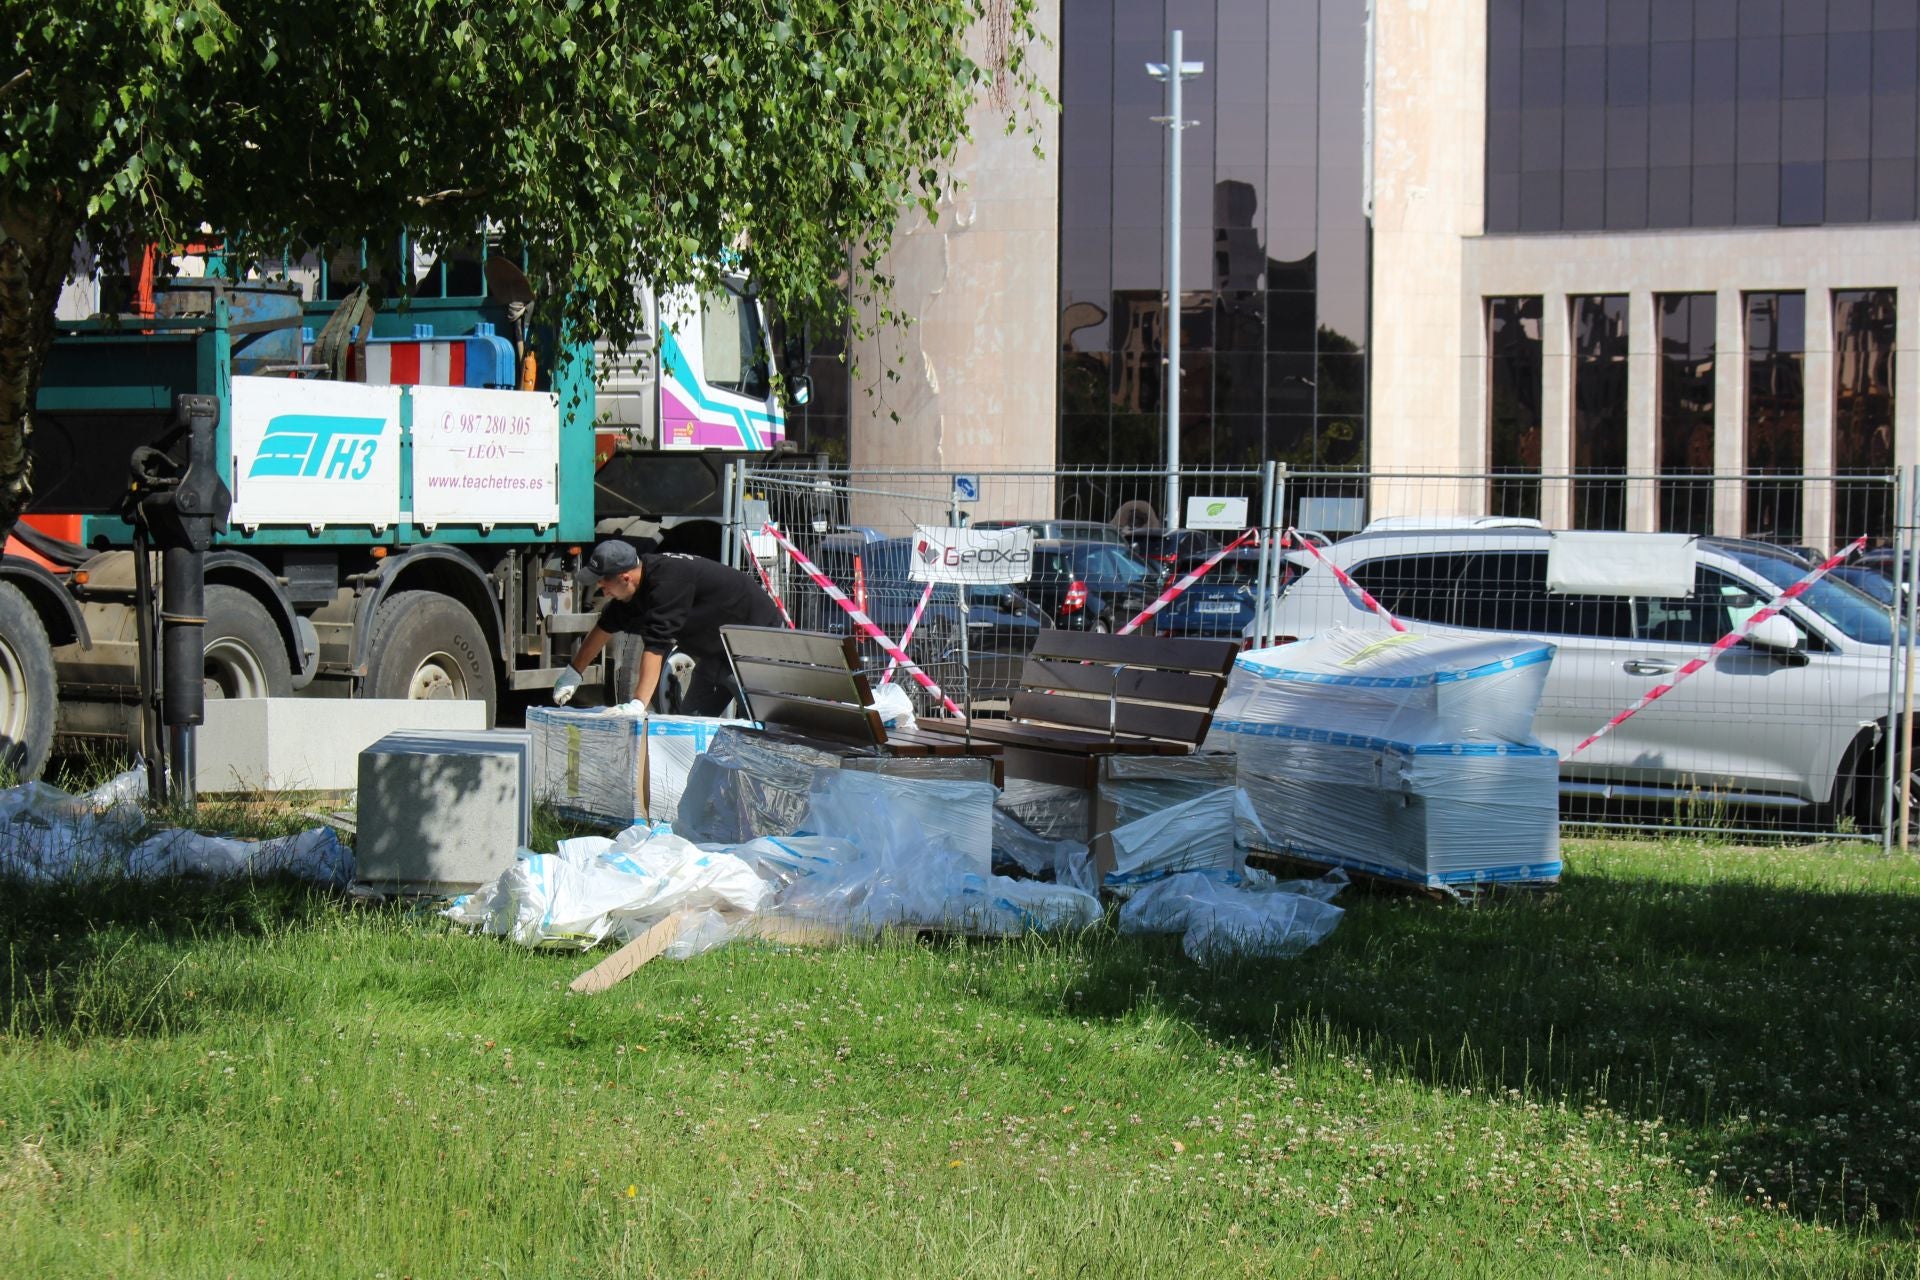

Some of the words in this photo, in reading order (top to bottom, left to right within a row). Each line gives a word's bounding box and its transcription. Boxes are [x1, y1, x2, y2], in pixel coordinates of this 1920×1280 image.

[460, 414, 482, 433] 987
[485, 415, 506, 434] 280
[509, 416, 530, 436] 305
[467, 440, 507, 459] LEÓN
[428, 474, 543, 490] www.teachetres.es
